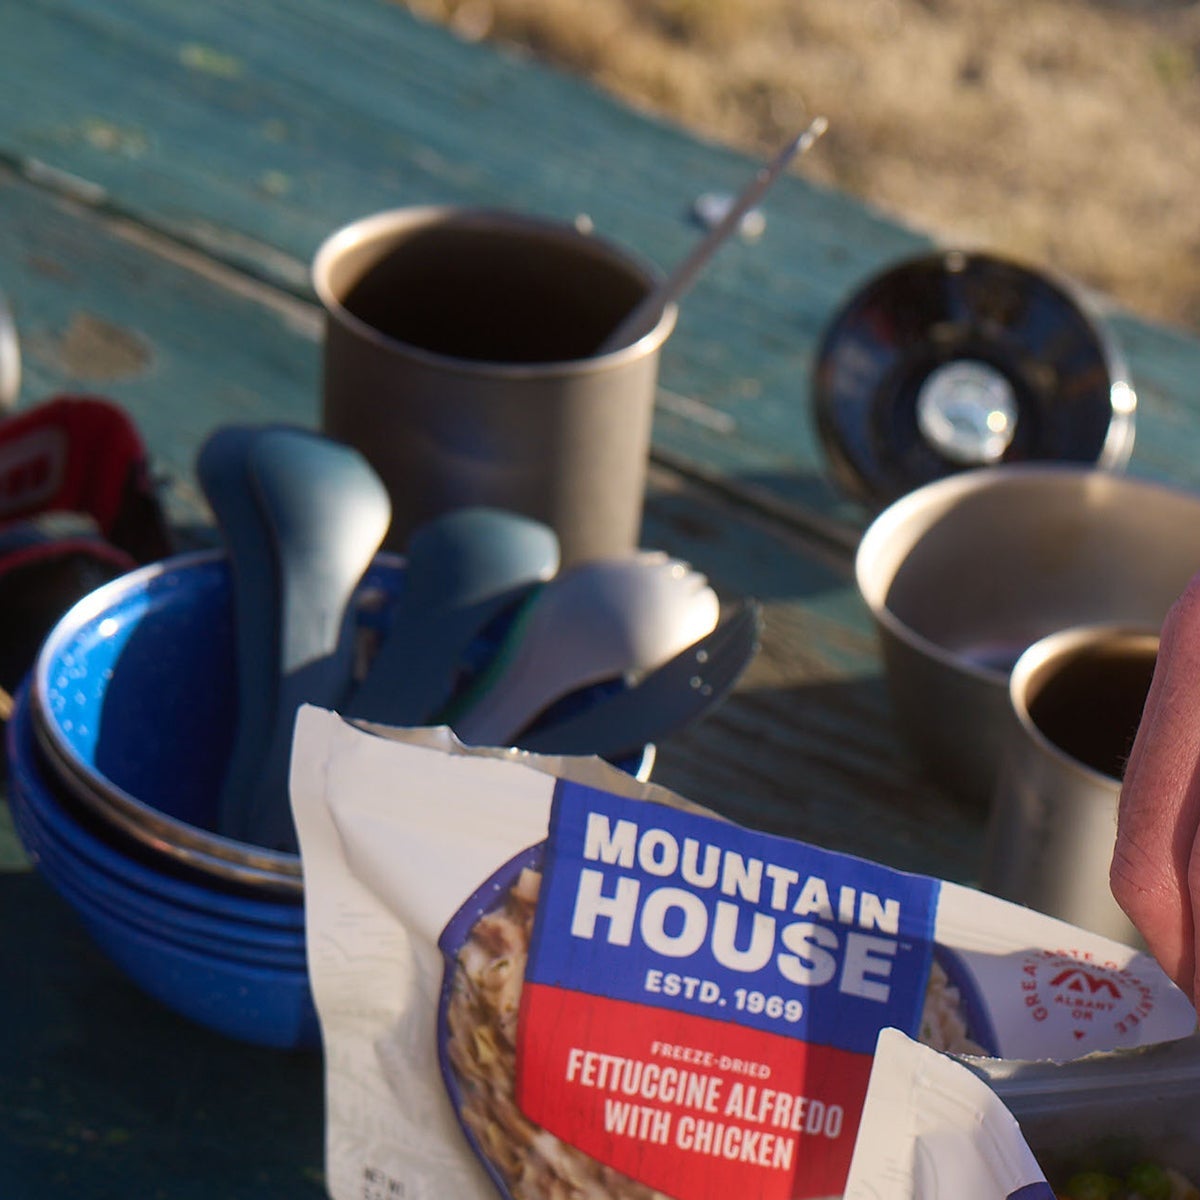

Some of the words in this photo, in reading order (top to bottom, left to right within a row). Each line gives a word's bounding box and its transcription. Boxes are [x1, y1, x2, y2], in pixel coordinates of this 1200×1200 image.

[583, 812, 900, 935] MOUNTAIN
[571, 868, 899, 1004] HOUSE
[644, 968, 727, 1007] ESTD.
[734, 988, 803, 1024] 1969
[565, 1048, 723, 1114] FETTUCCINE
[724, 1082, 844, 1140] ALFREDO
[651, 1041, 772, 1080] FREEZE-DRIED
[604, 1098, 672, 1146] WITH
[675, 1115, 795, 1171] CHICKEN
